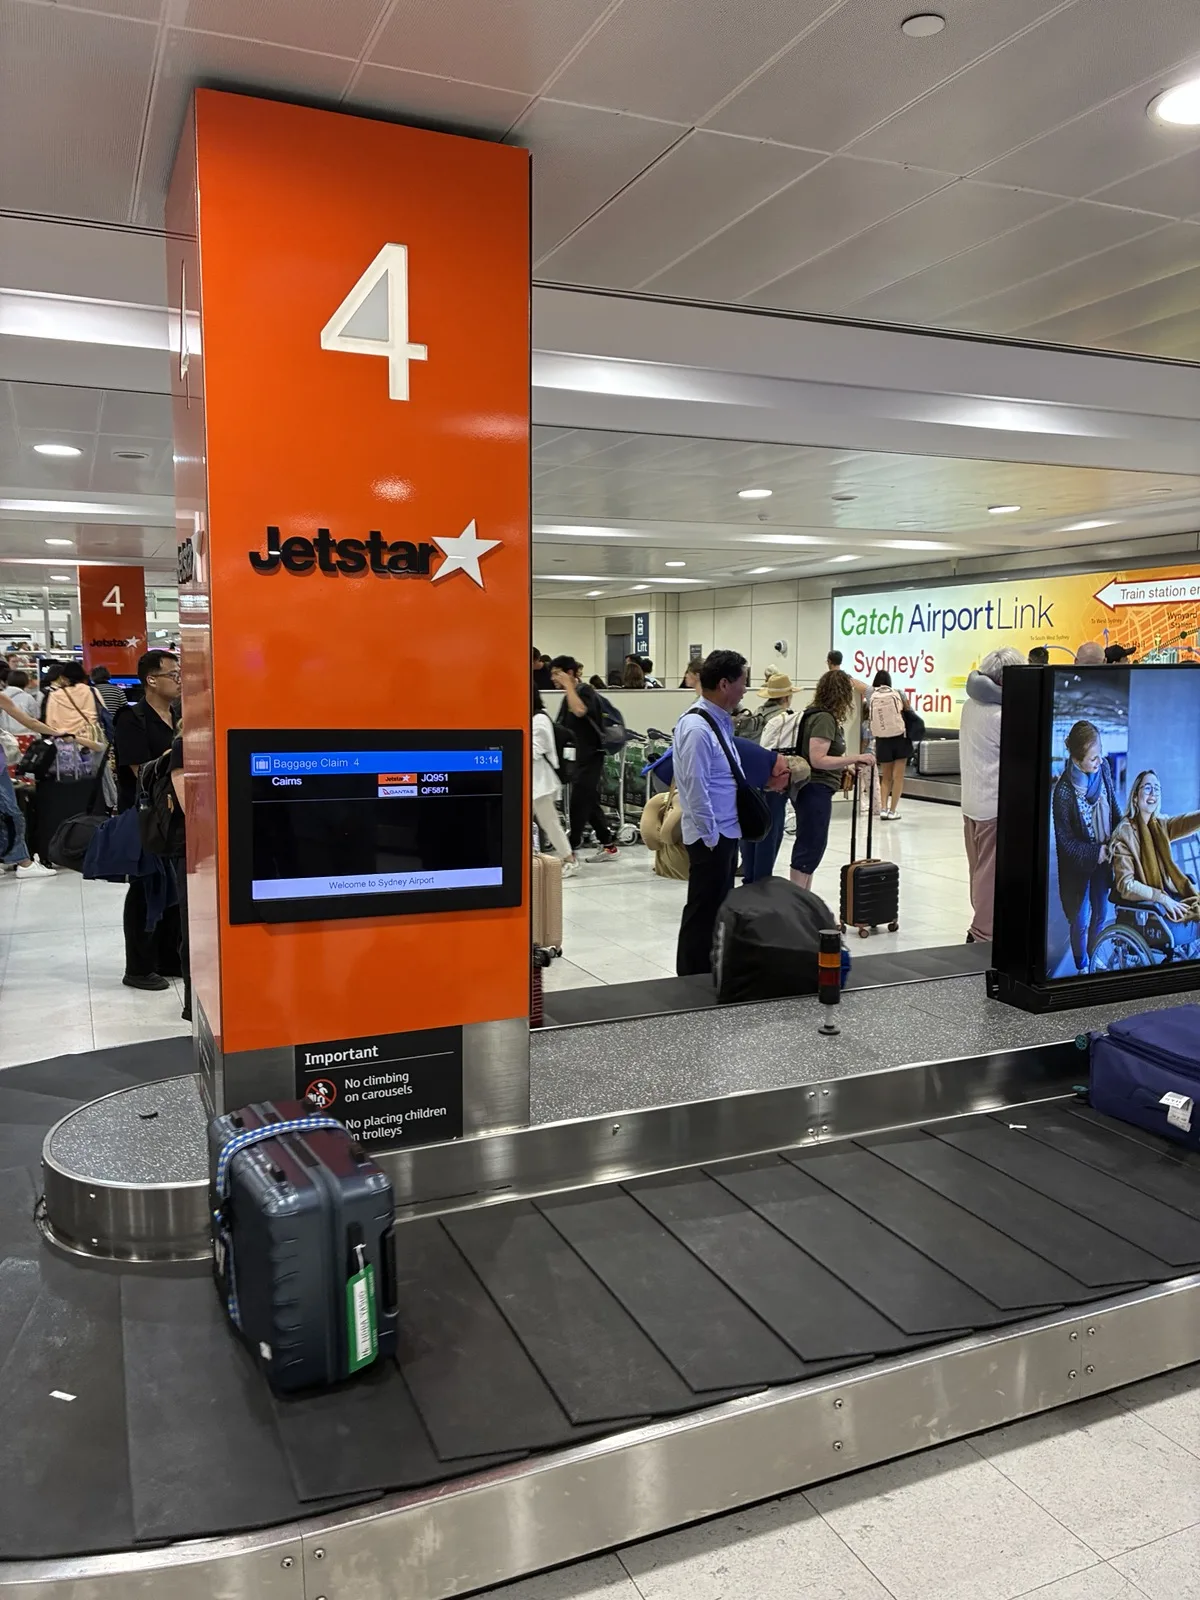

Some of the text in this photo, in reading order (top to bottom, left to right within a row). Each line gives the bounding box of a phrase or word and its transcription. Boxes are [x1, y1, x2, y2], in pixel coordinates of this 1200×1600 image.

[320, 242, 428, 401] 4
[249, 526, 438, 575] Jetstar
[102, 585, 125, 615] 4
[1120, 588, 1145, 600] Train
[1148, 585, 1186, 598] station
[841, 605, 904, 636] Catch
[637, 641, 648, 652] Lift
[904, 688, 952, 713] Train
[273, 757, 360, 769] Baggage Claim 4
[474, 755, 499, 765] 13:14
[421, 773, 449, 782] JQ951
[421, 787, 449, 795] QF5871
[329, 877, 435, 889] Welcome to Sydney Airport
[304, 1045, 379, 1066] Important
[344, 1072, 410, 1089] No climbing
[344, 1084, 413, 1103] on carousels
[345, 1107, 447, 1130] No placing children
[349, 1125, 403, 1143] n trolleys
